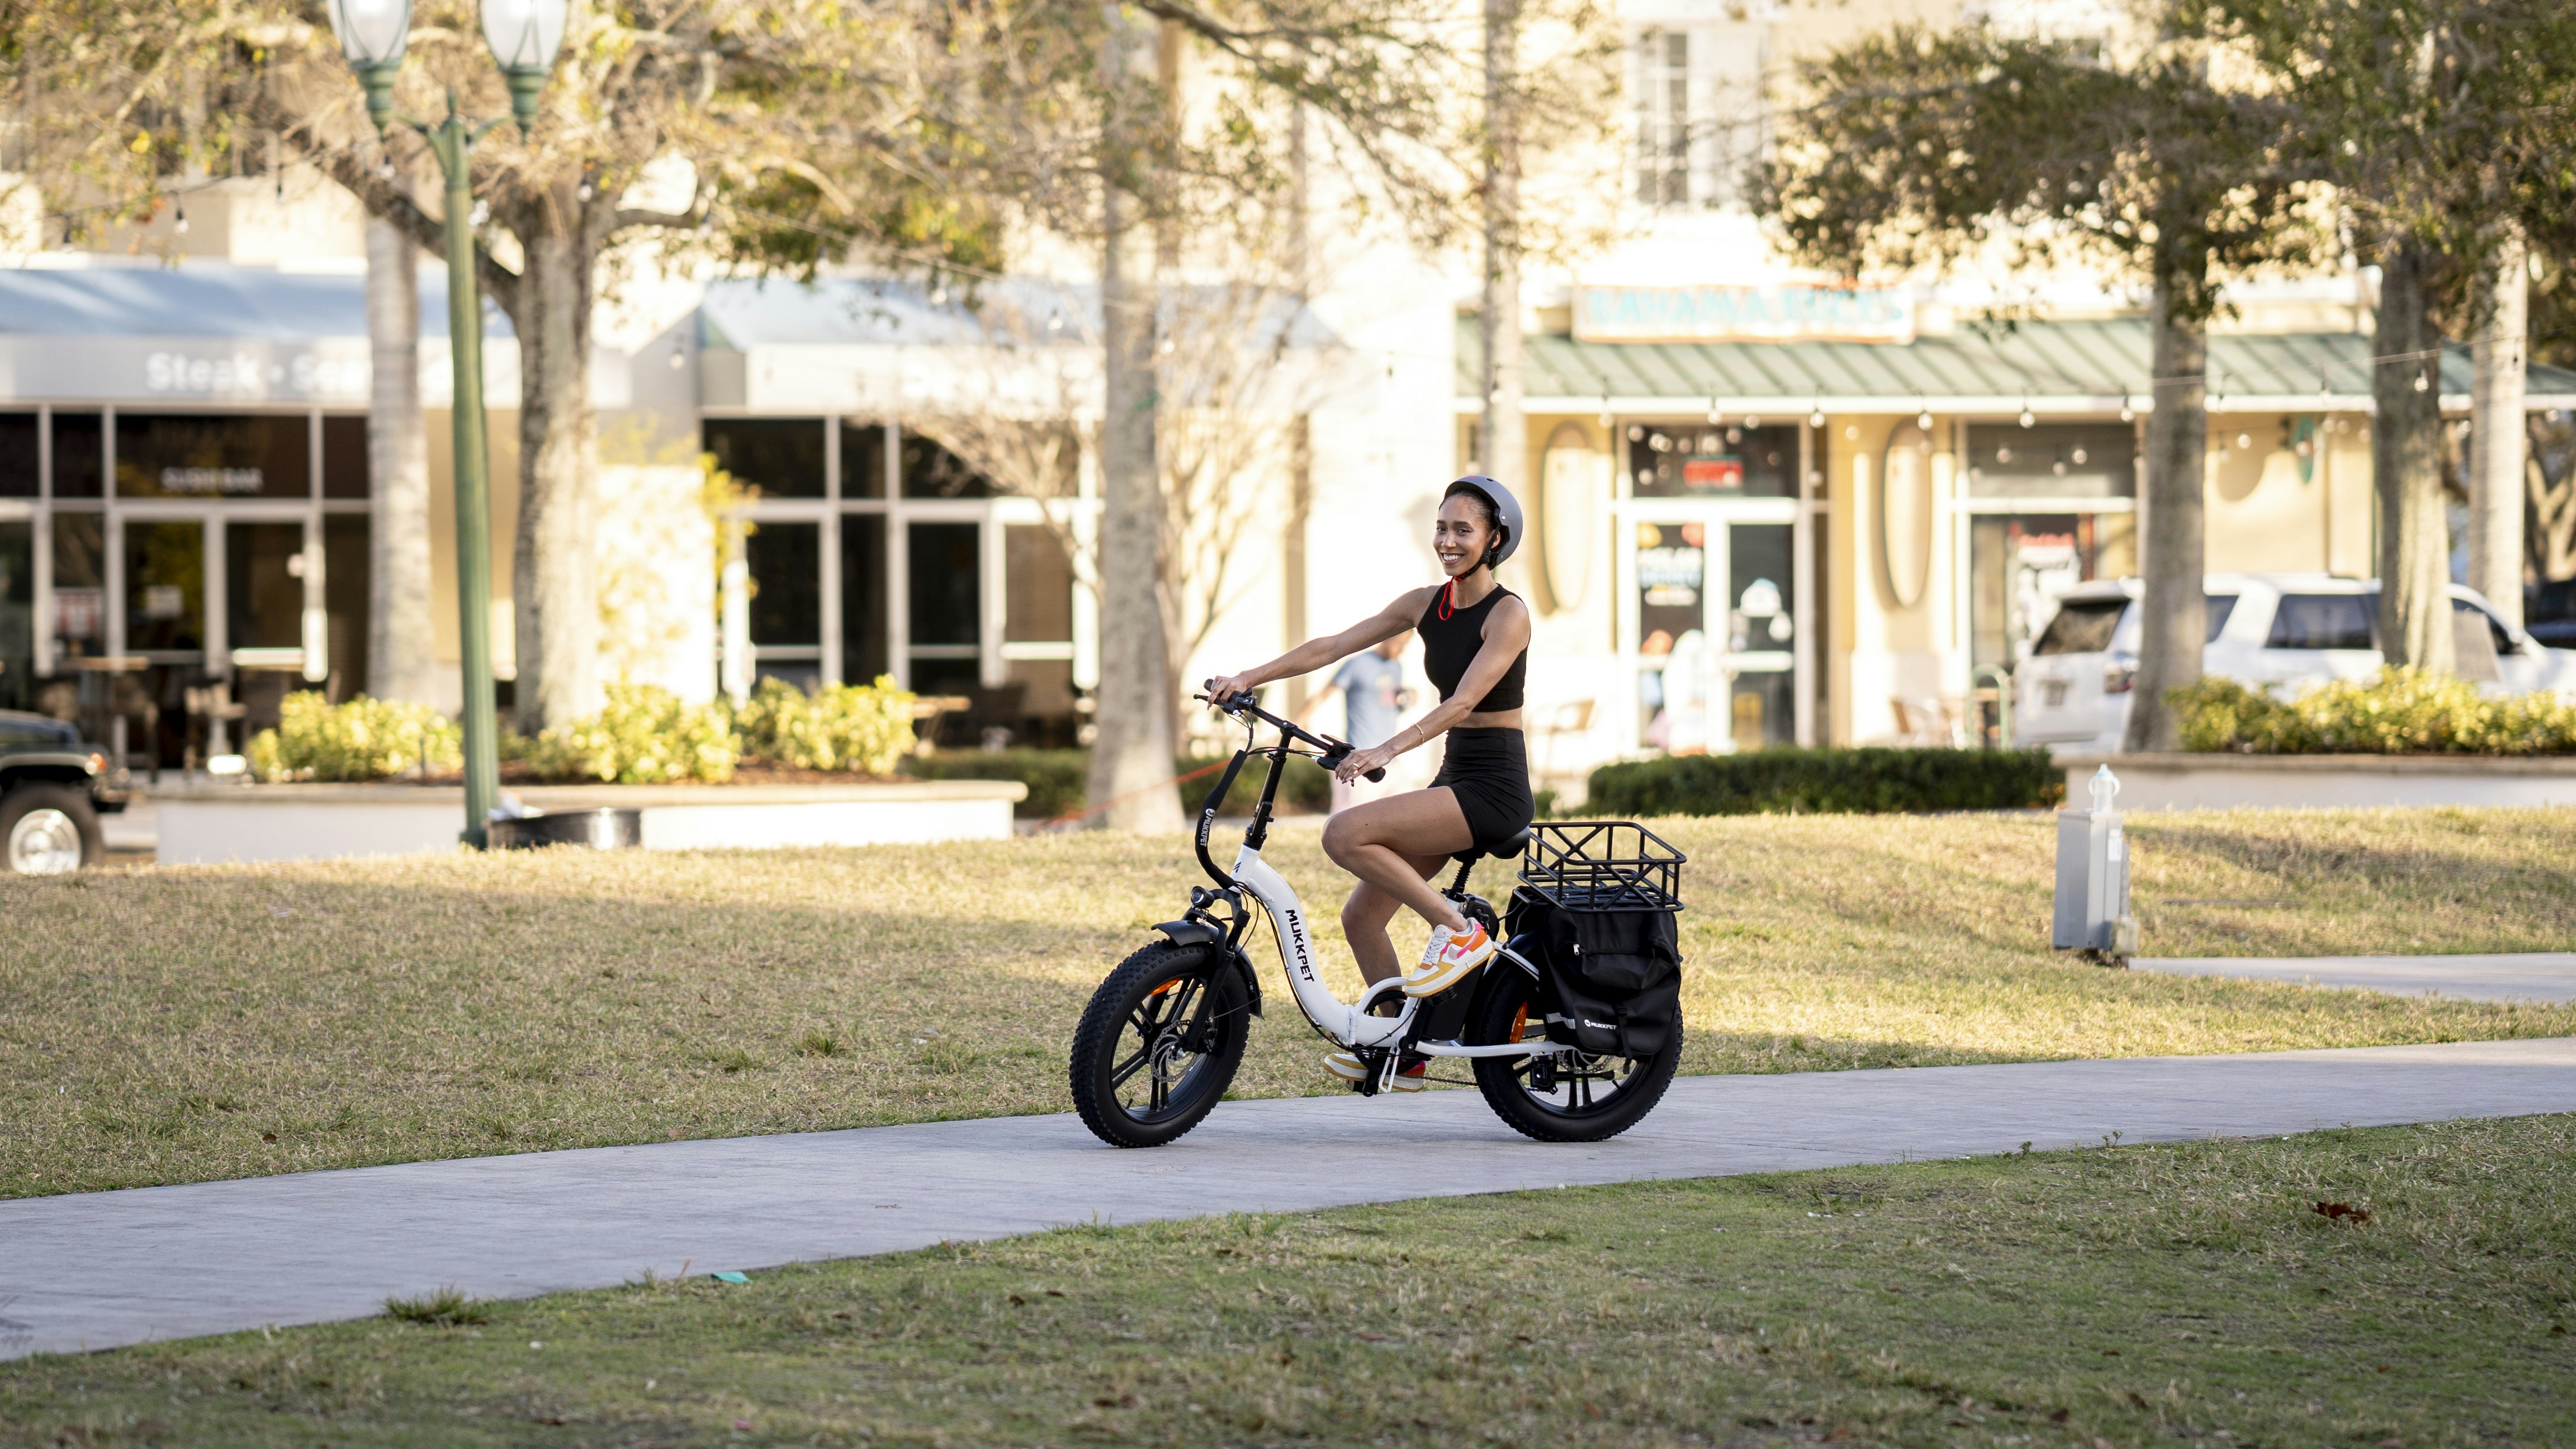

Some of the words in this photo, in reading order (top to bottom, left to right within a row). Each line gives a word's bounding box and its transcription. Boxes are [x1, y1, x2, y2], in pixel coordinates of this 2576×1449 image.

[149, 353, 260, 390] Steak
[1200, 816, 1212, 847] MUKKPET
[1285, 909, 1315, 982] MUKKPET
